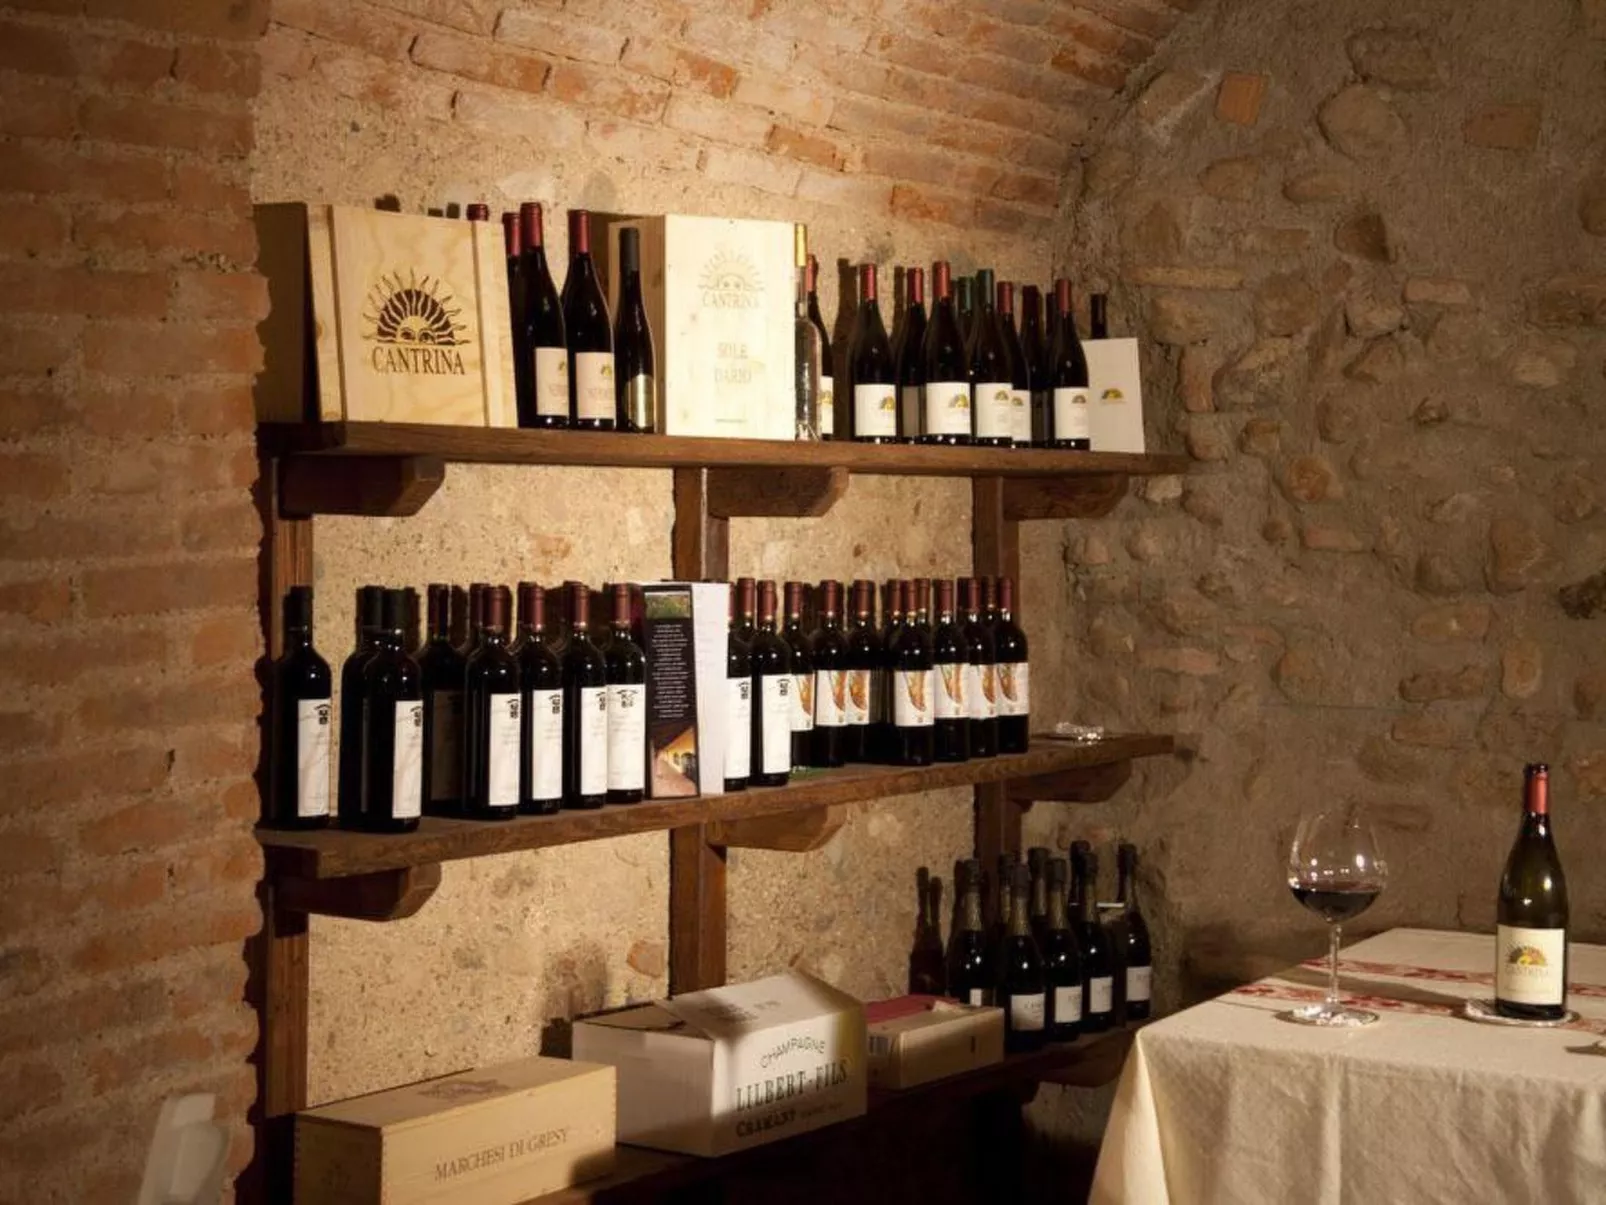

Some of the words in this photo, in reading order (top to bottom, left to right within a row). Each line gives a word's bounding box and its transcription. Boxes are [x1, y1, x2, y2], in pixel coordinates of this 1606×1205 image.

[702, 290, 760, 309] CANTRINA
[371, 345, 465, 376] CANTRINA
[760, 1036, 826, 1069] CHAMPAGNE
[435, 1144, 504, 1182] MARCHESI
[510, 1138, 525, 1159] DI
